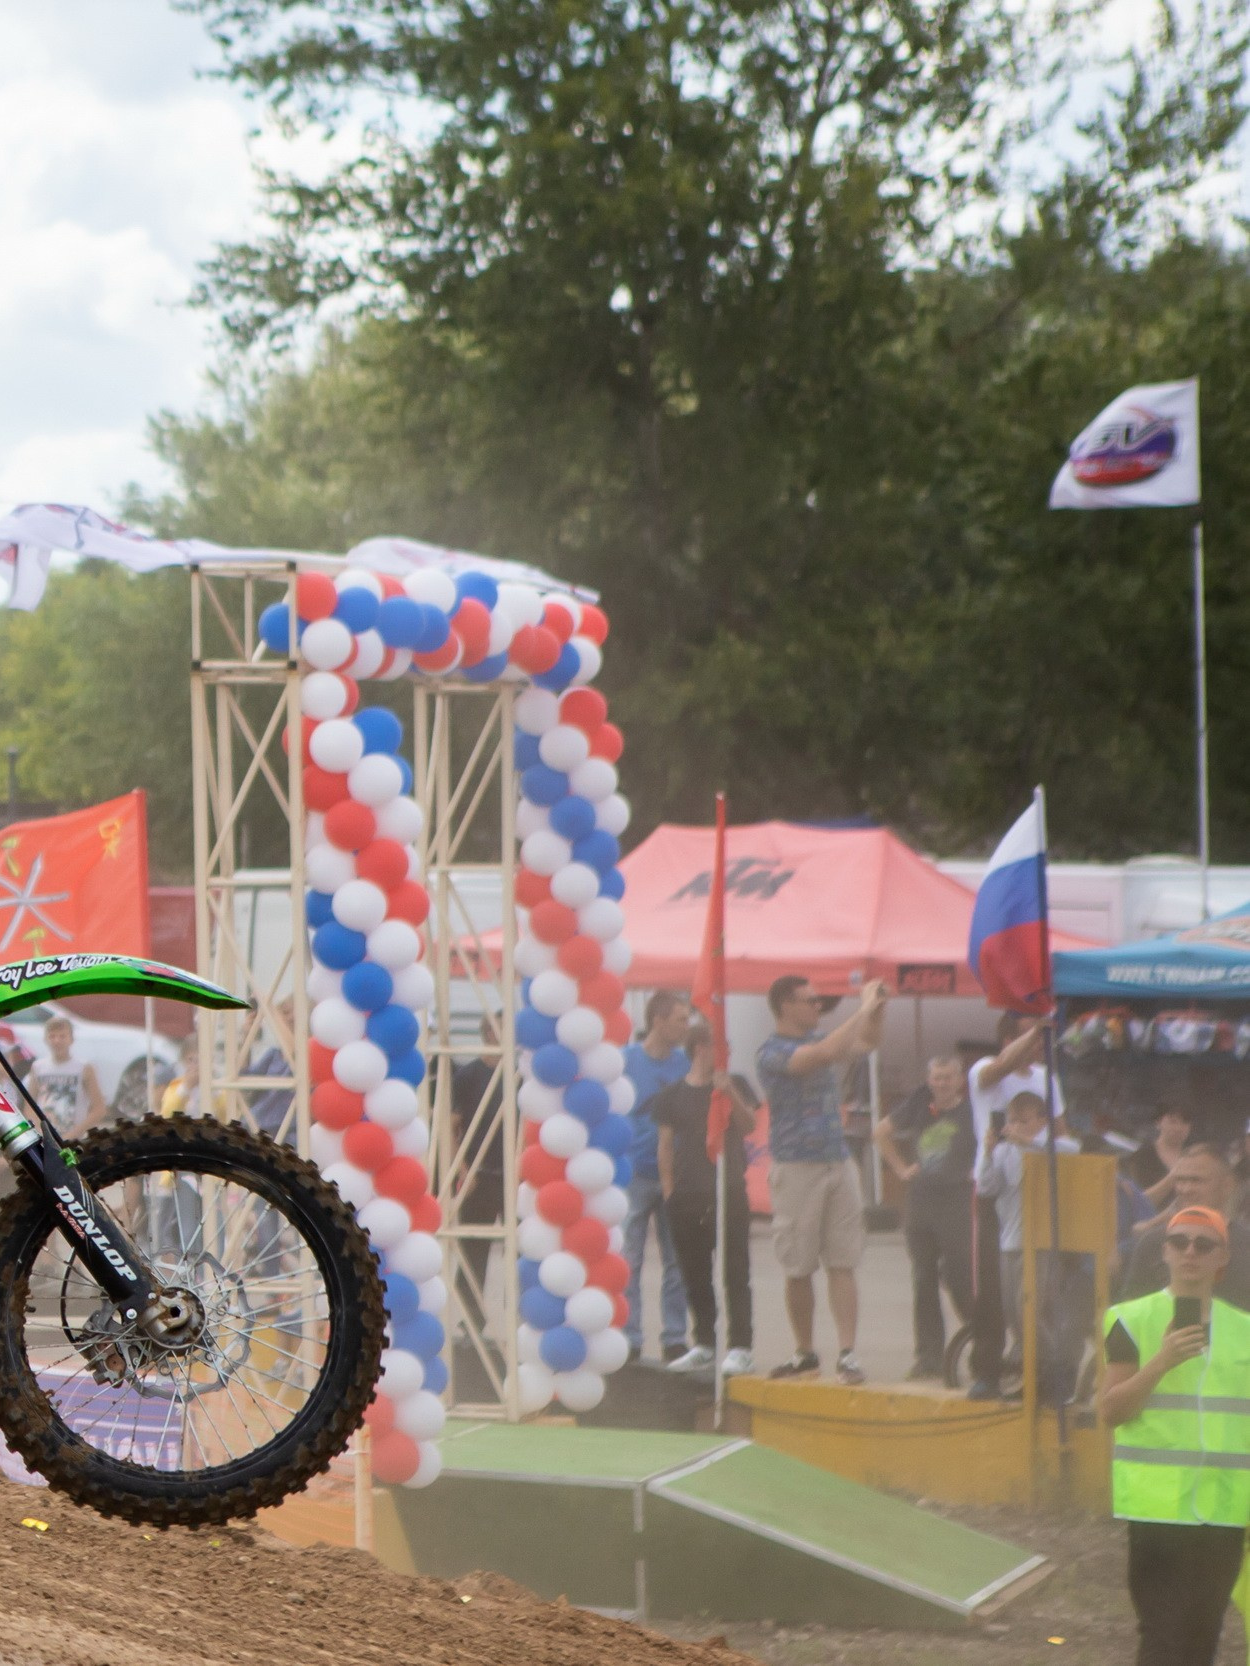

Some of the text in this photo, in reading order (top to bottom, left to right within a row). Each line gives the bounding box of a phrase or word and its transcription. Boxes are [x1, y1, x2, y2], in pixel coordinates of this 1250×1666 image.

[26, 960, 57, 979] Lee
[58, 954, 115, 972] Designs
[53, 1185, 138, 1282] DUNLOP
